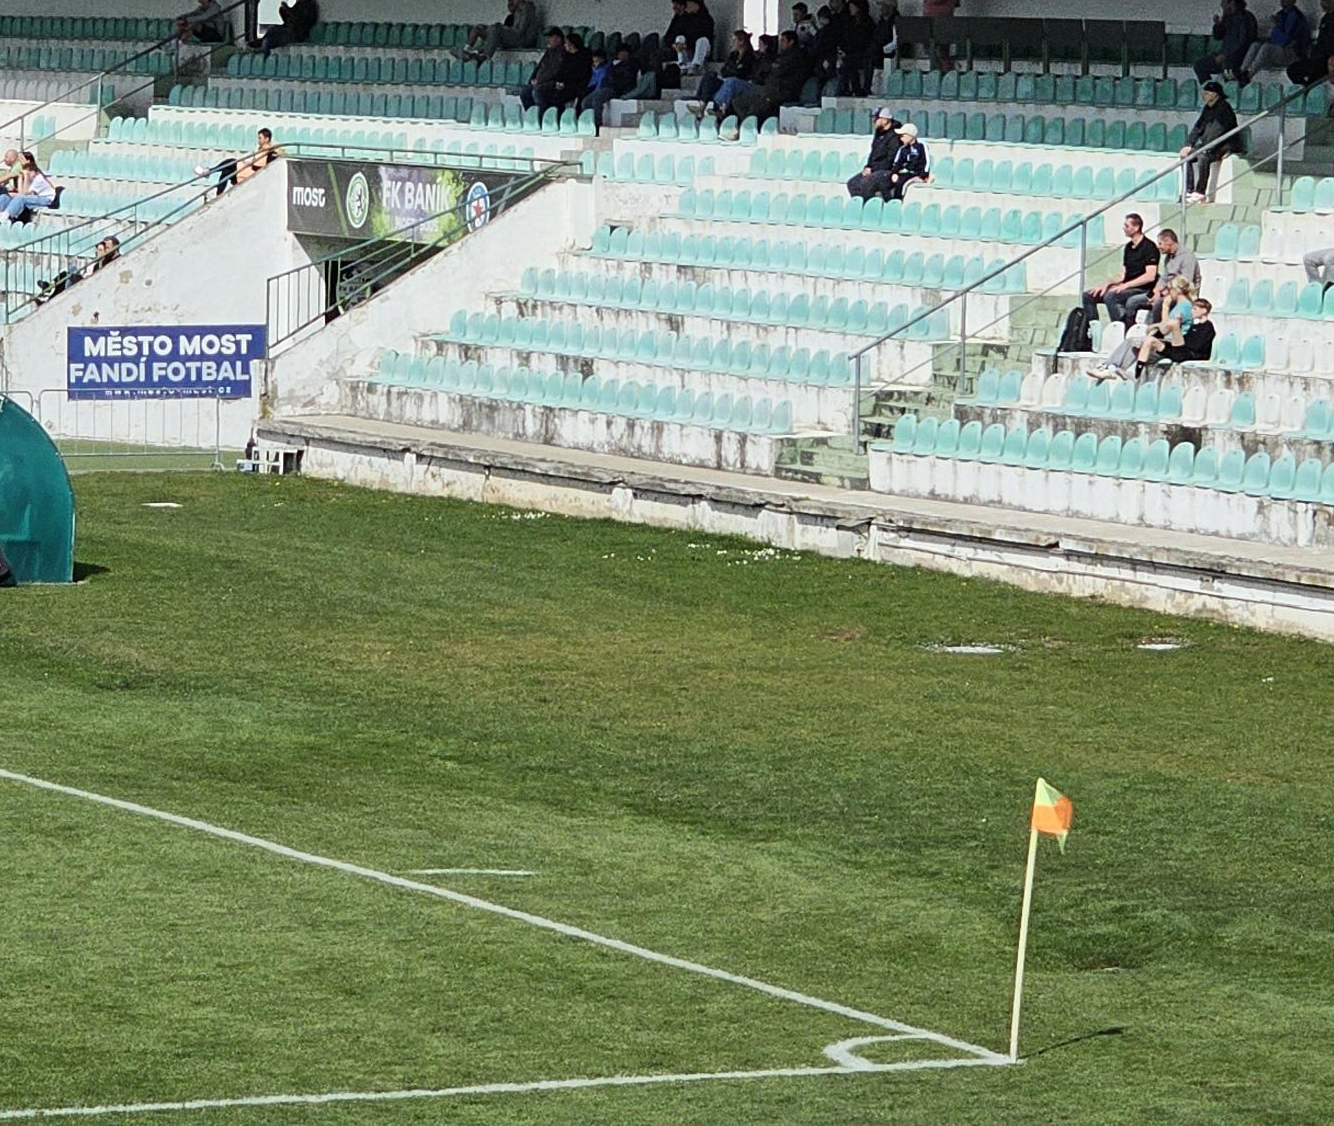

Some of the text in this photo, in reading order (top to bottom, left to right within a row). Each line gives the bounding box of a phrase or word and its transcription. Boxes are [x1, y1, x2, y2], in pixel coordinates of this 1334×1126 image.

[292, 186, 326, 208] most
[382, 176, 451, 211] FK BANÍK
[84, 330, 253, 357] MĚSTO MOST
[69, 357, 147, 383] FANDÍ
